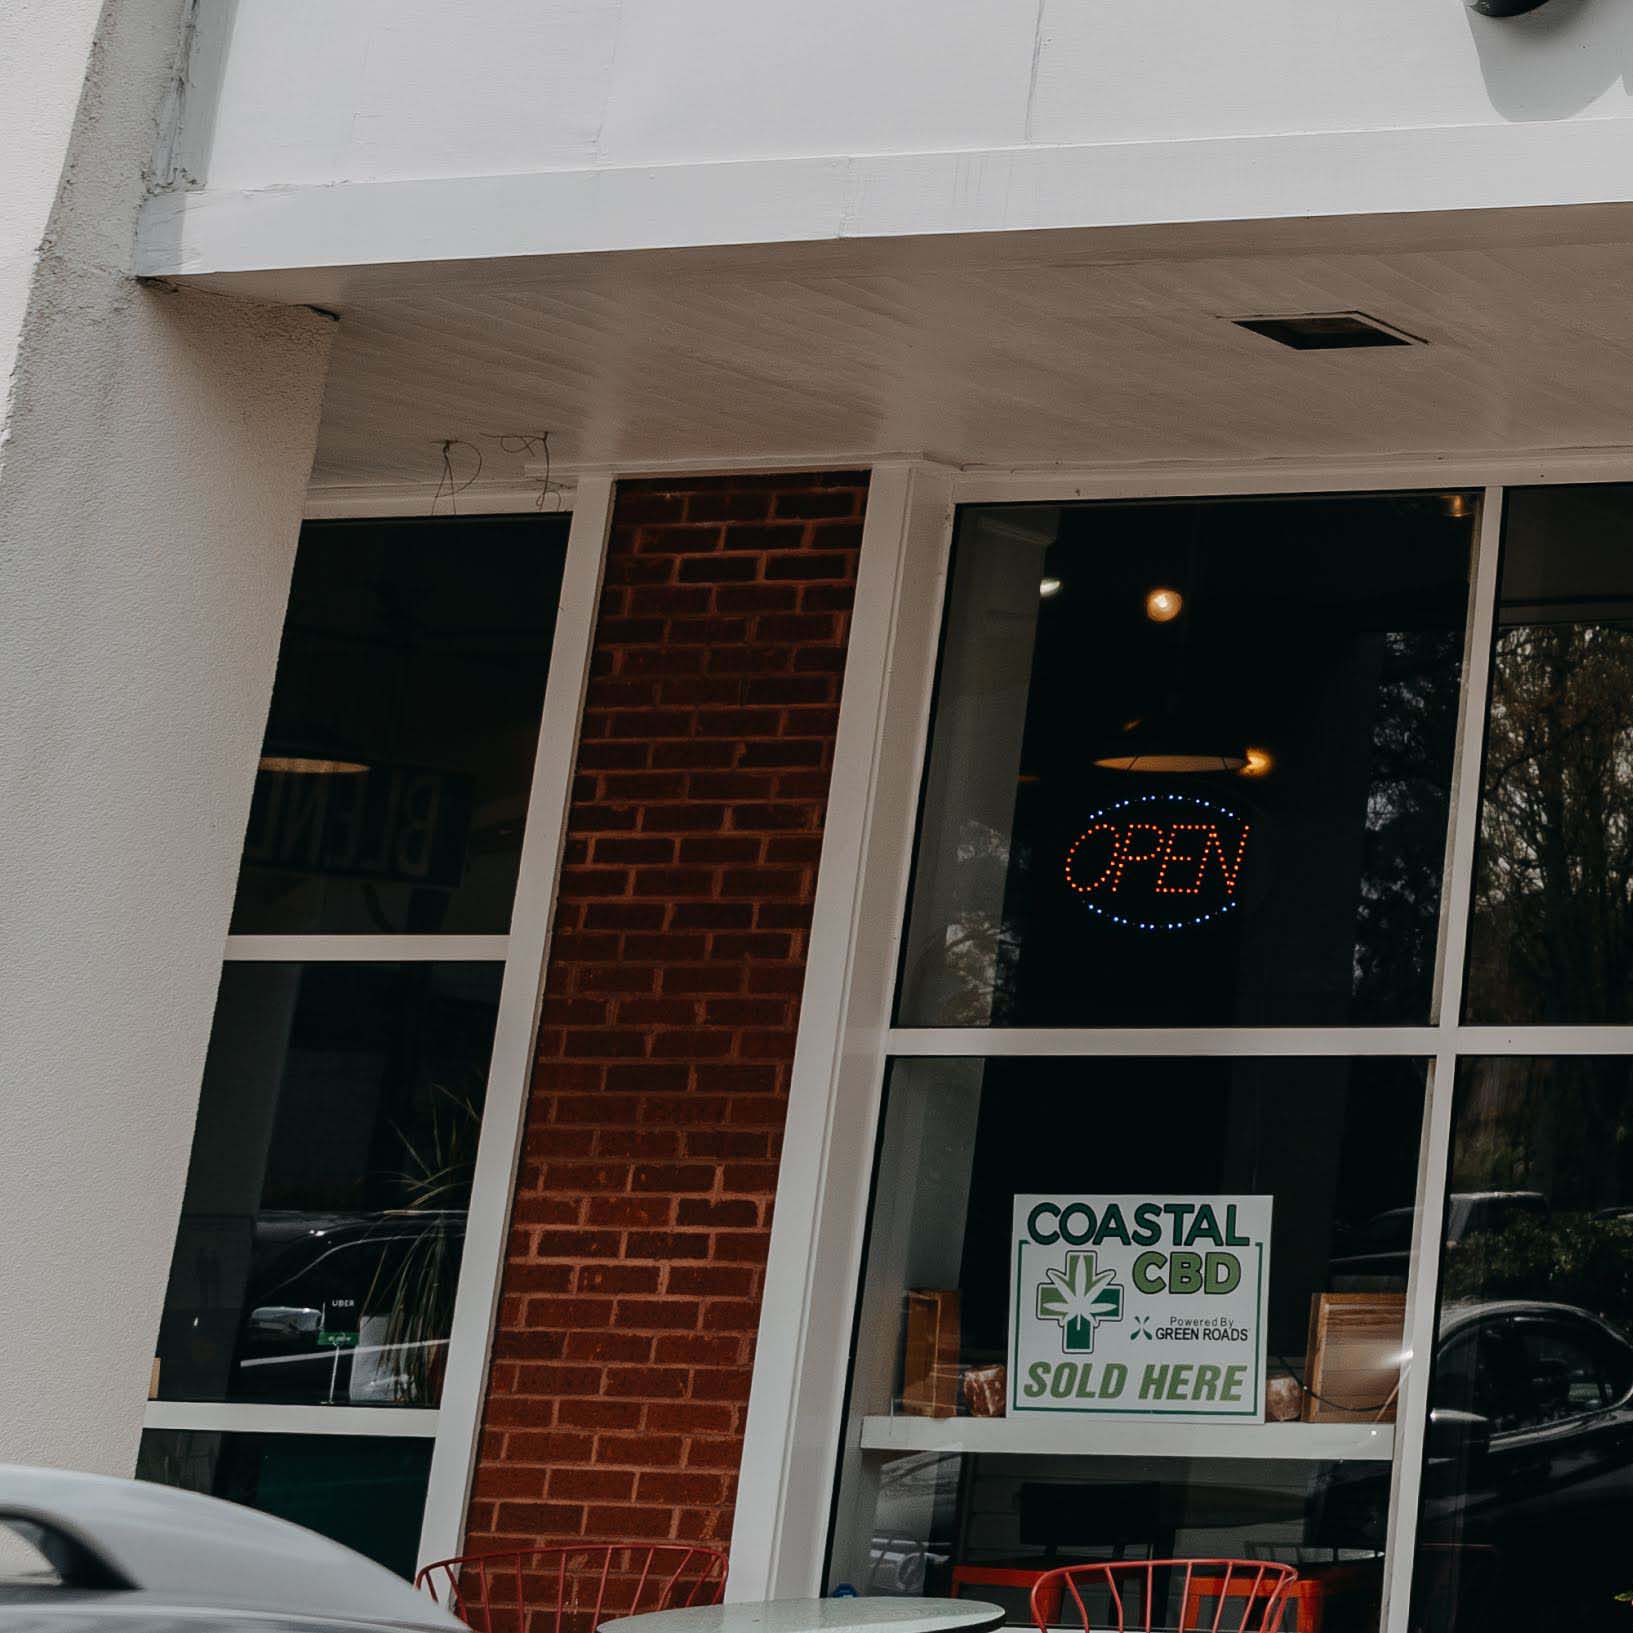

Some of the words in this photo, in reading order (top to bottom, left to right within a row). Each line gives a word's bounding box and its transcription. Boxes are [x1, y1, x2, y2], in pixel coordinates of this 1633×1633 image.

[1064, 823, 1250, 894] OPEN
[1026, 1201, 1251, 1247] COASTAL
[1131, 1250, 1242, 1296] CBD
[1155, 1327, 1200, 1341] GREEN
[1202, 1328, 1249, 1342] ROADS
[1169, 1316, 1218, 1327] Powered
[1219, 1316, 1235, 1329] By
[1022, 1361, 1129, 1400] SOLD
[1137, 1363, 1249, 1402] HERE
